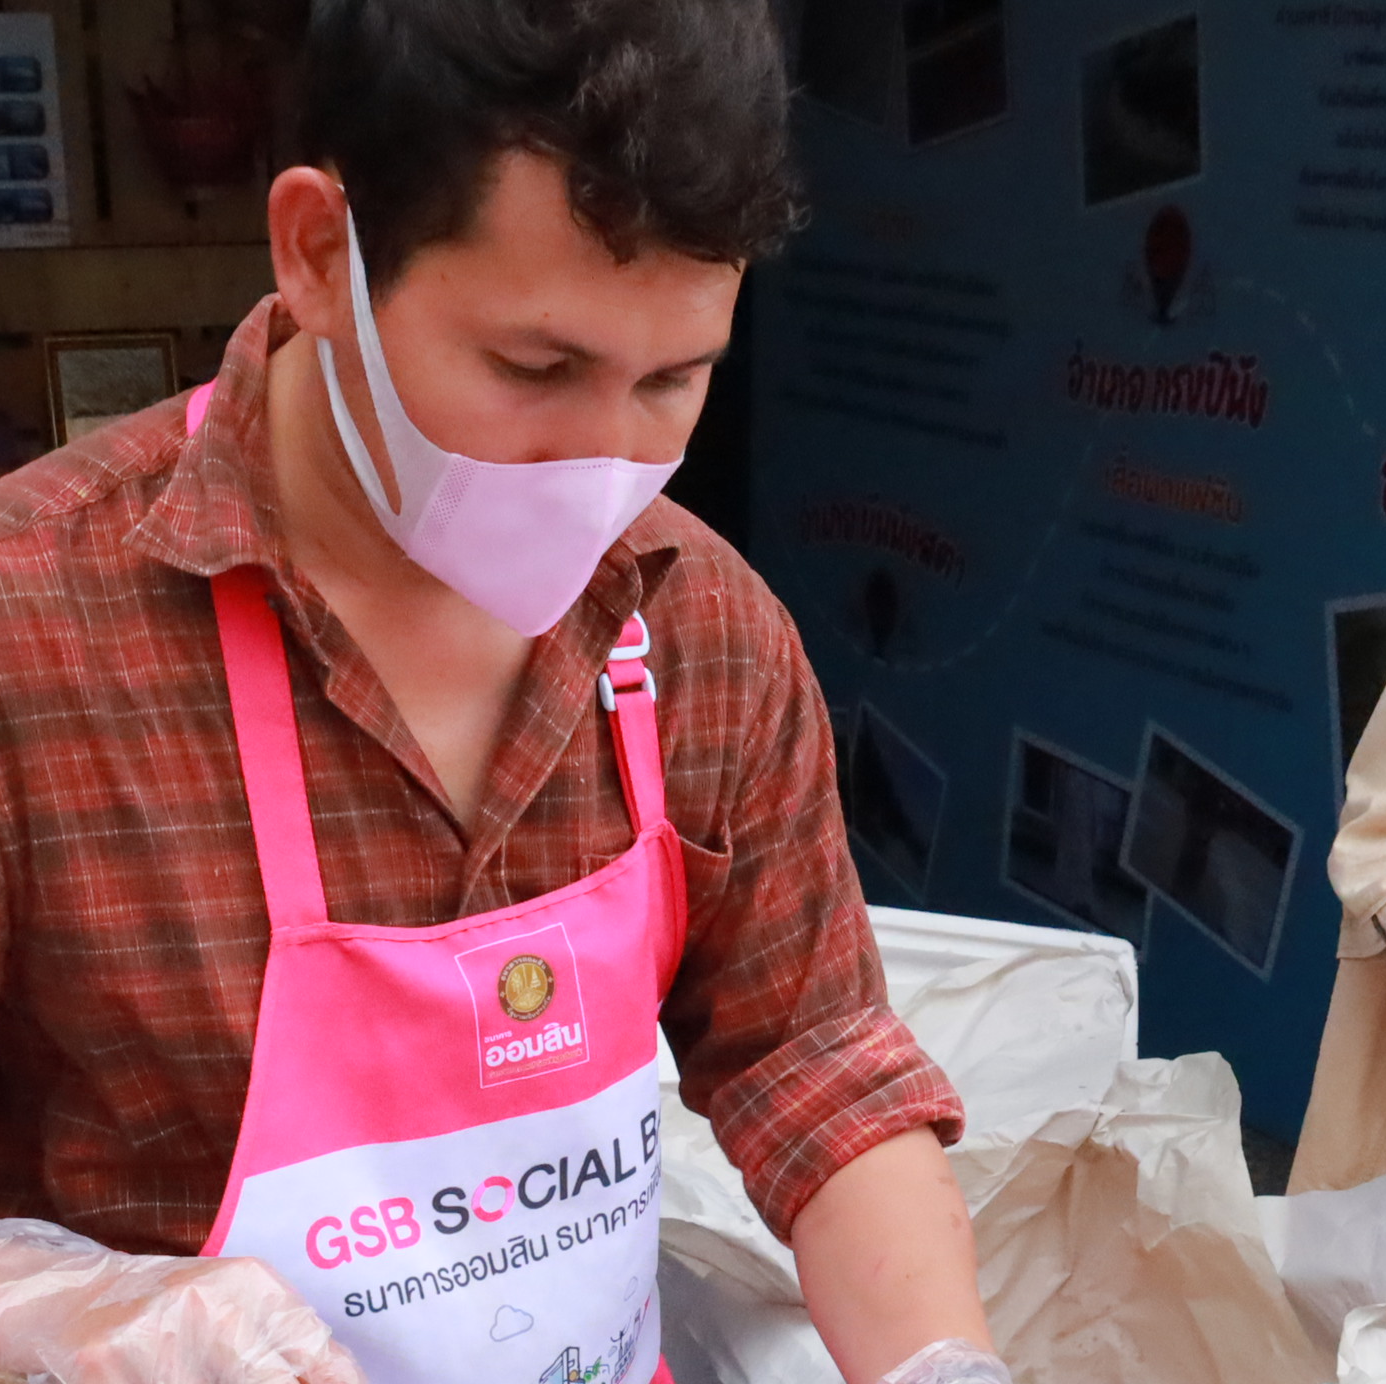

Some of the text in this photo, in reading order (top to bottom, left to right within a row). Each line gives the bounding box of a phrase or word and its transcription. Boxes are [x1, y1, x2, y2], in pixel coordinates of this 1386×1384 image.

[485, 1022, 583, 1067] ออมสิน
[305, 1195, 422, 1270] GSB
[431, 1137, 637, 1235] SOCIAL
[344, 1235, 549, 1318] ธนาคารออมสิน
